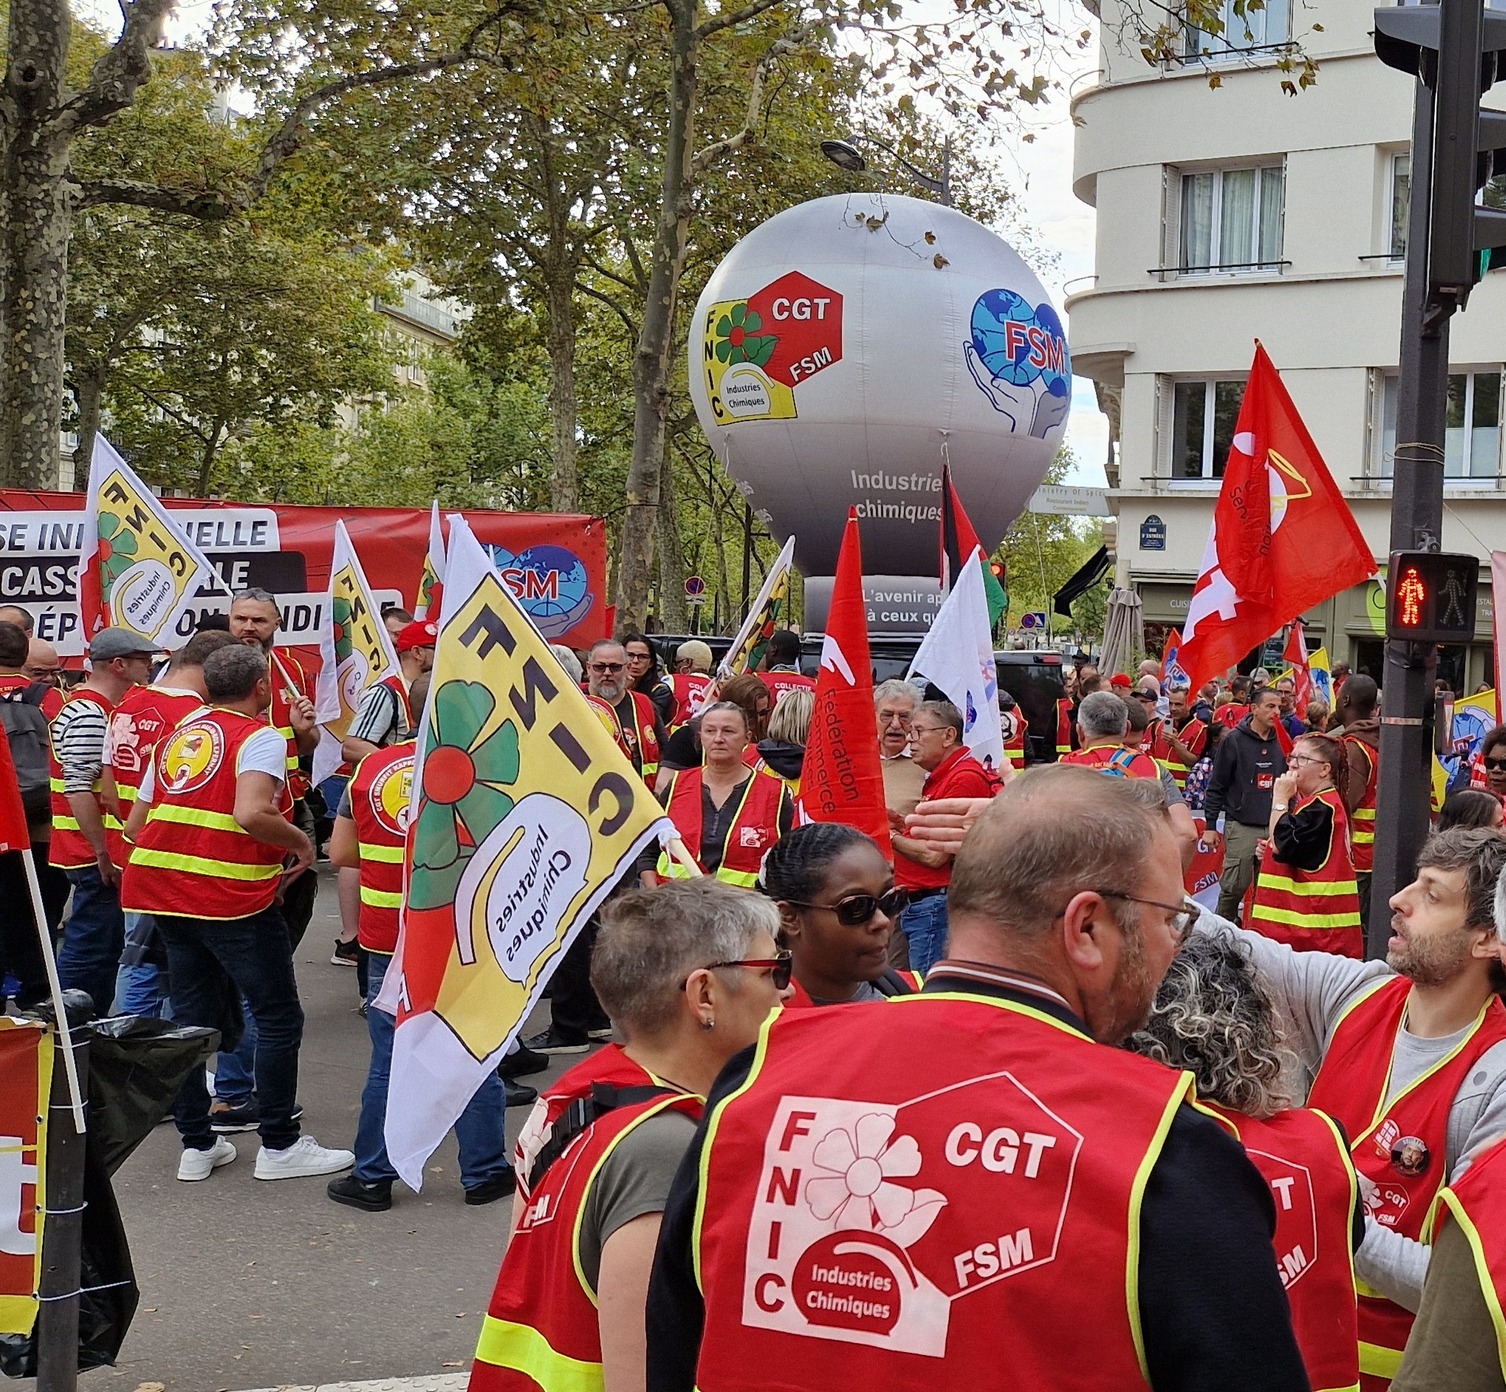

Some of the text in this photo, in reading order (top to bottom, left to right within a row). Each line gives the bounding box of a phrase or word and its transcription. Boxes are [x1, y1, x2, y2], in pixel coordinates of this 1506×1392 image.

[772, 297, 831, 321] CGT
[1005, 320, 1067, 377] FSM
[788, 346, 833, 383] FSM
[725, 381, 762, 394] Industries
[728, 395, 766, 409] Chimiques
[850, 469, 943, 492] Industrie
[501, 568, 559, 600] SM
[863, 589, 926, 604] L'avenir
[867, 608, 877, 623] à
[880, 611, 918, 623] ceux
[138, 719, 160, 732] CGT
[824, 688, 859, 801] Fédération
[944, 1121, 1057, 1179] CGT
[754, 1111, 816, 1313] FNIC
[1385, 1190, 1407, 1208] CGT
[1377, 1214, 1396, 1224] FSM
[953, 1228, 1034, 1289] FSM
[811, 1263, 892, 1292] Industries
[806, 1290, 890, 1320] Chimiques
